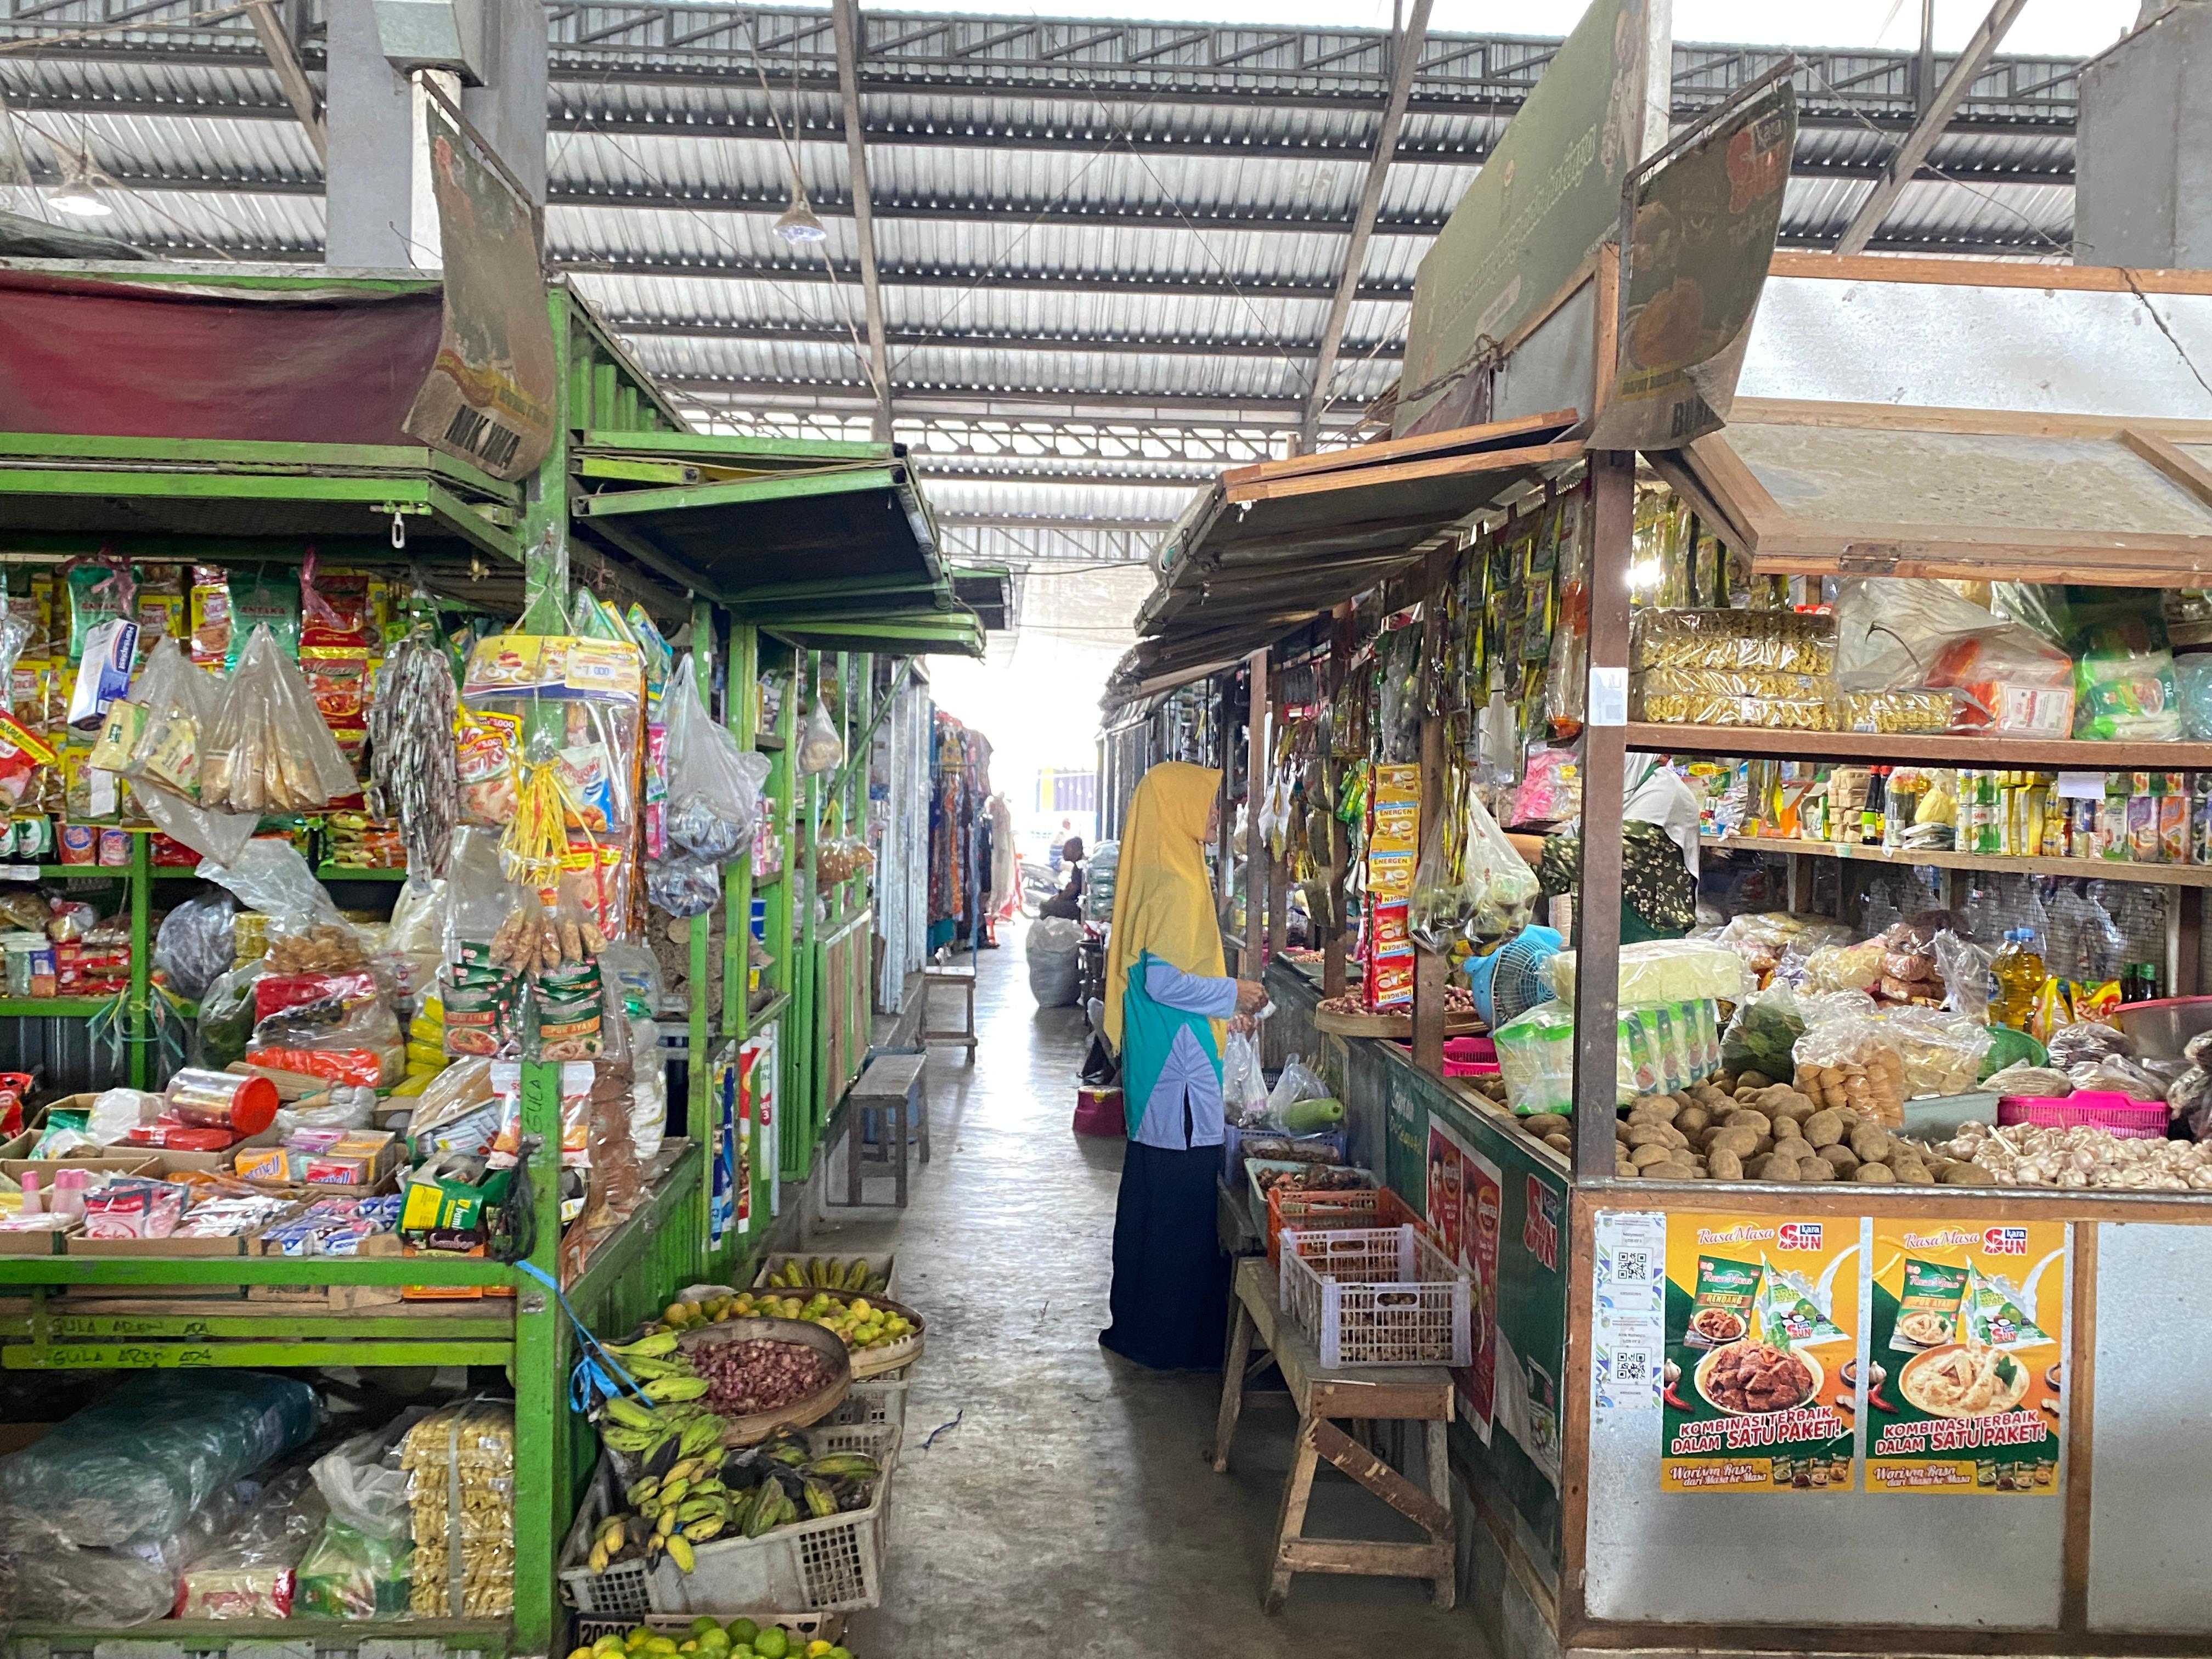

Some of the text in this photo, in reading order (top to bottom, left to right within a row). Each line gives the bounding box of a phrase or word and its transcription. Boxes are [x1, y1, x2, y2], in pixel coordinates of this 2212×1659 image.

[118, 625, 136, 670] Hansaplast
[1374, 857, 1408, 865] ENERGEN
[1381, 989, 1412, 1000] ENERGEN
[527, 1079, 543, 1133] GULA
[1779, 1224, 1821, 1250] SUN
[1801, 1225, 1821, 1234] kara
[2006, 1229, 2026, 1239] kara
[1983, 1228, 2027, 1254] SUN
[1706, 1294, 1743, 1305] RENDANG
[54, 1350, 104, 1365] GULA
[1680, 1407, 1832, 1436] KOMBINASI TERBAIK
[1884, 1410, 2038, 1437] KOMBINASI TERBAIK
[1672, 1418, 1842, 1453] DALAM SATU PAKET!
[1876, 1422, 2047, 1454] DALAM SATU PAKET!
[1670, 1464, 1752, 1480] Warisan Rasa
[1683, 1476, 1702, 1486] dari
[1874, 1464, 1957, 1481] Warisan Rasa
[582, 1624, 636, 1646] 200
